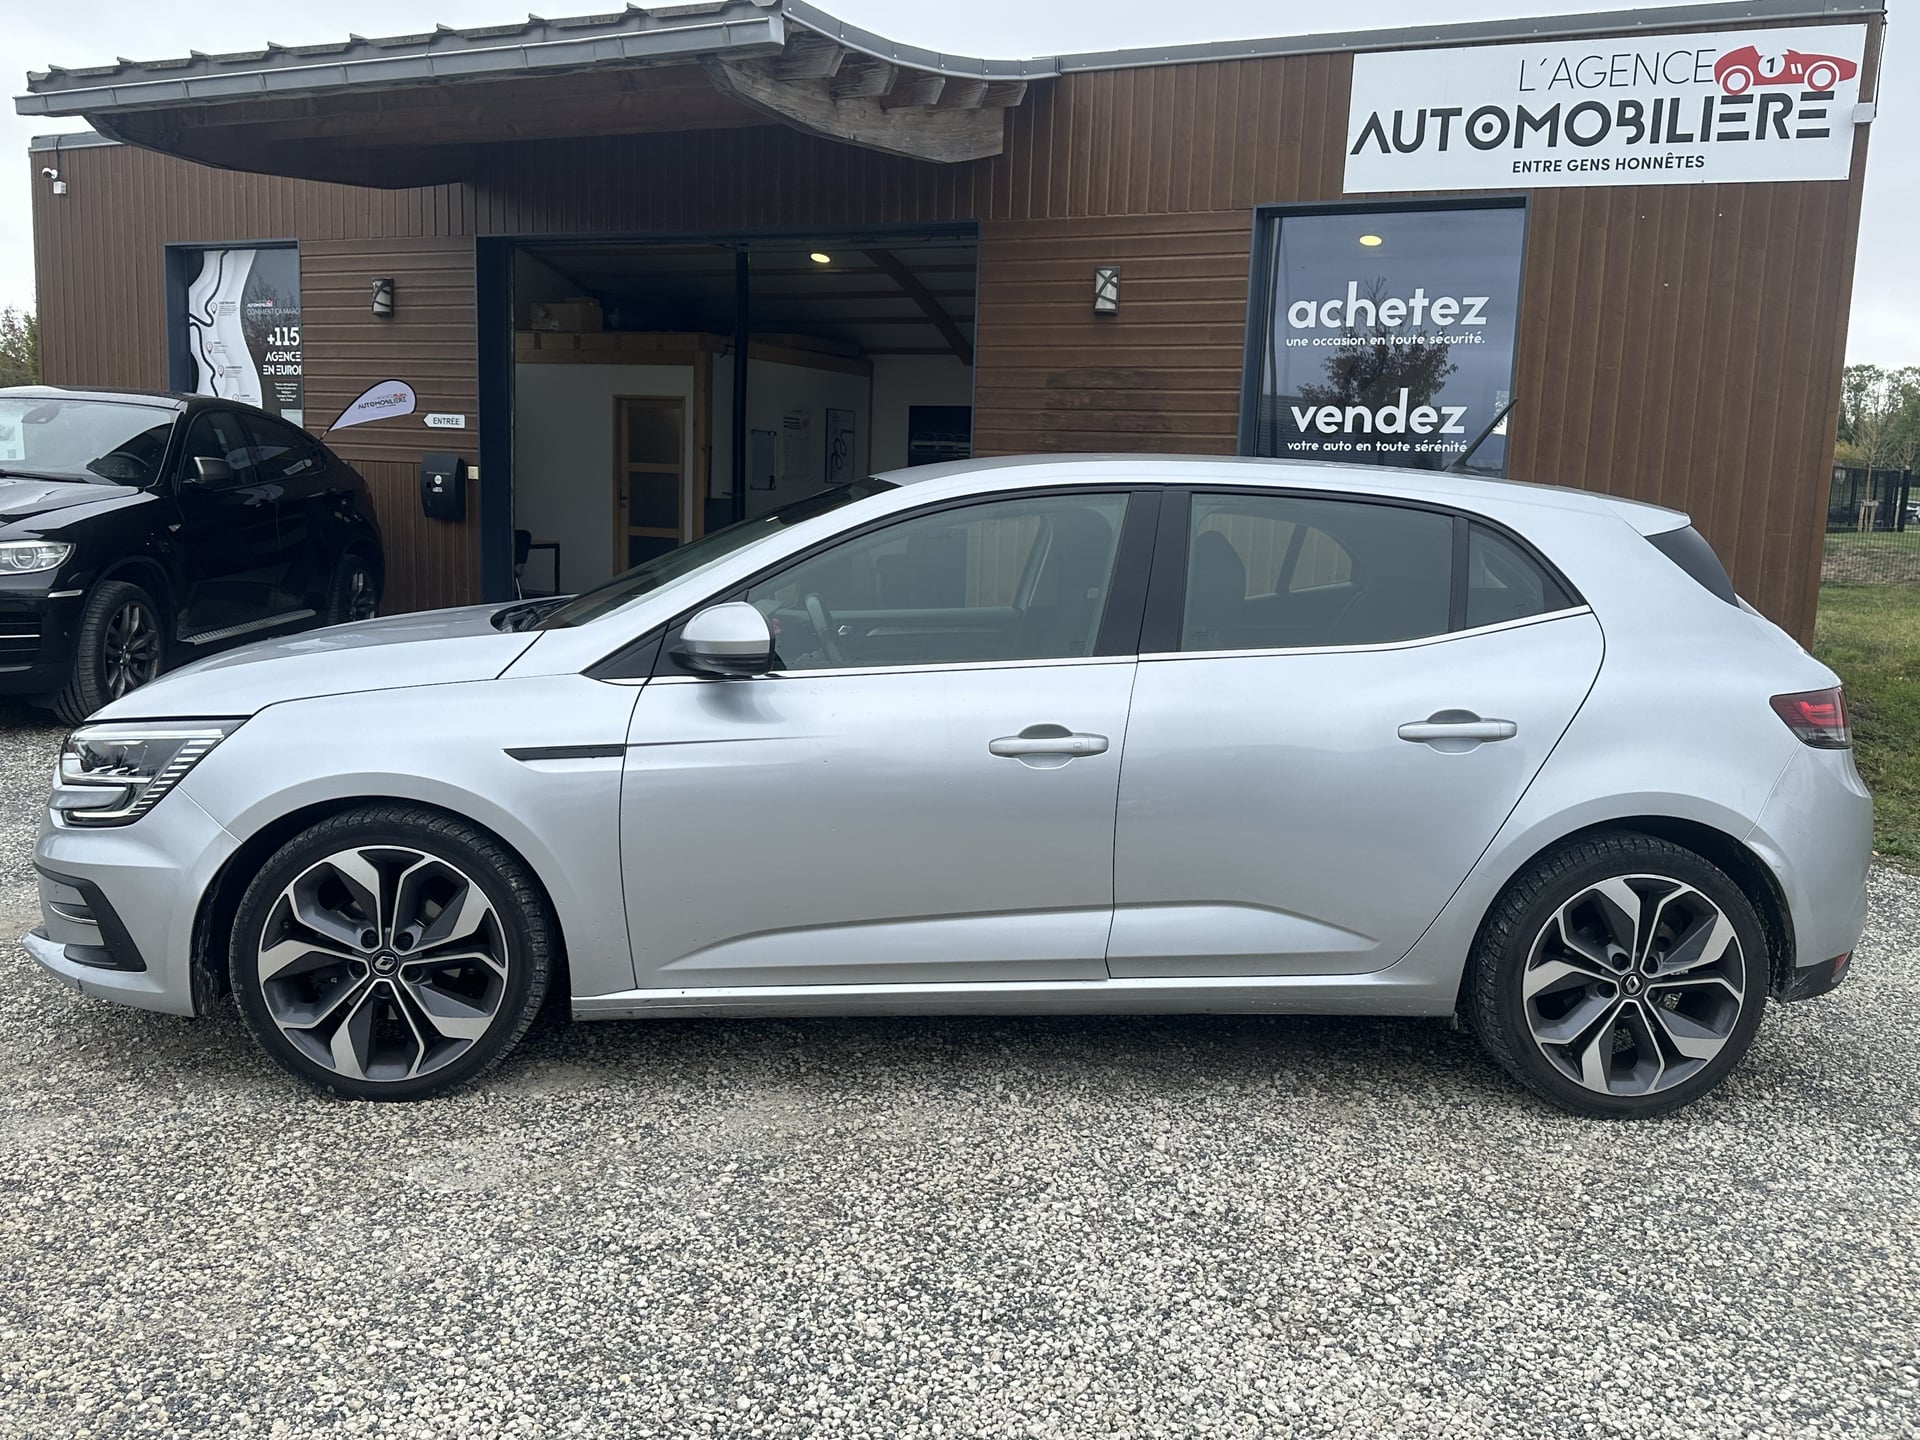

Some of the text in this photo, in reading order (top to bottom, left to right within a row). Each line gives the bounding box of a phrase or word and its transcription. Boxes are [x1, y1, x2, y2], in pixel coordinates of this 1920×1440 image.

[1765, 56, 1776, 73] 1
[1512, 152, 1705, 173] ENTRE GENS HONNÊTES
[1287, 281, 1490, 329] achetez
[267, 327, 300, 346] +115
[1286, 331, 1486, 347] une occasion en toute sécurité.
[263, 365, 275, 375] EN
[1290, 388, 1468, 434] vendez
[1287, 440, 1468, 453] votre auto en toute sérénité
